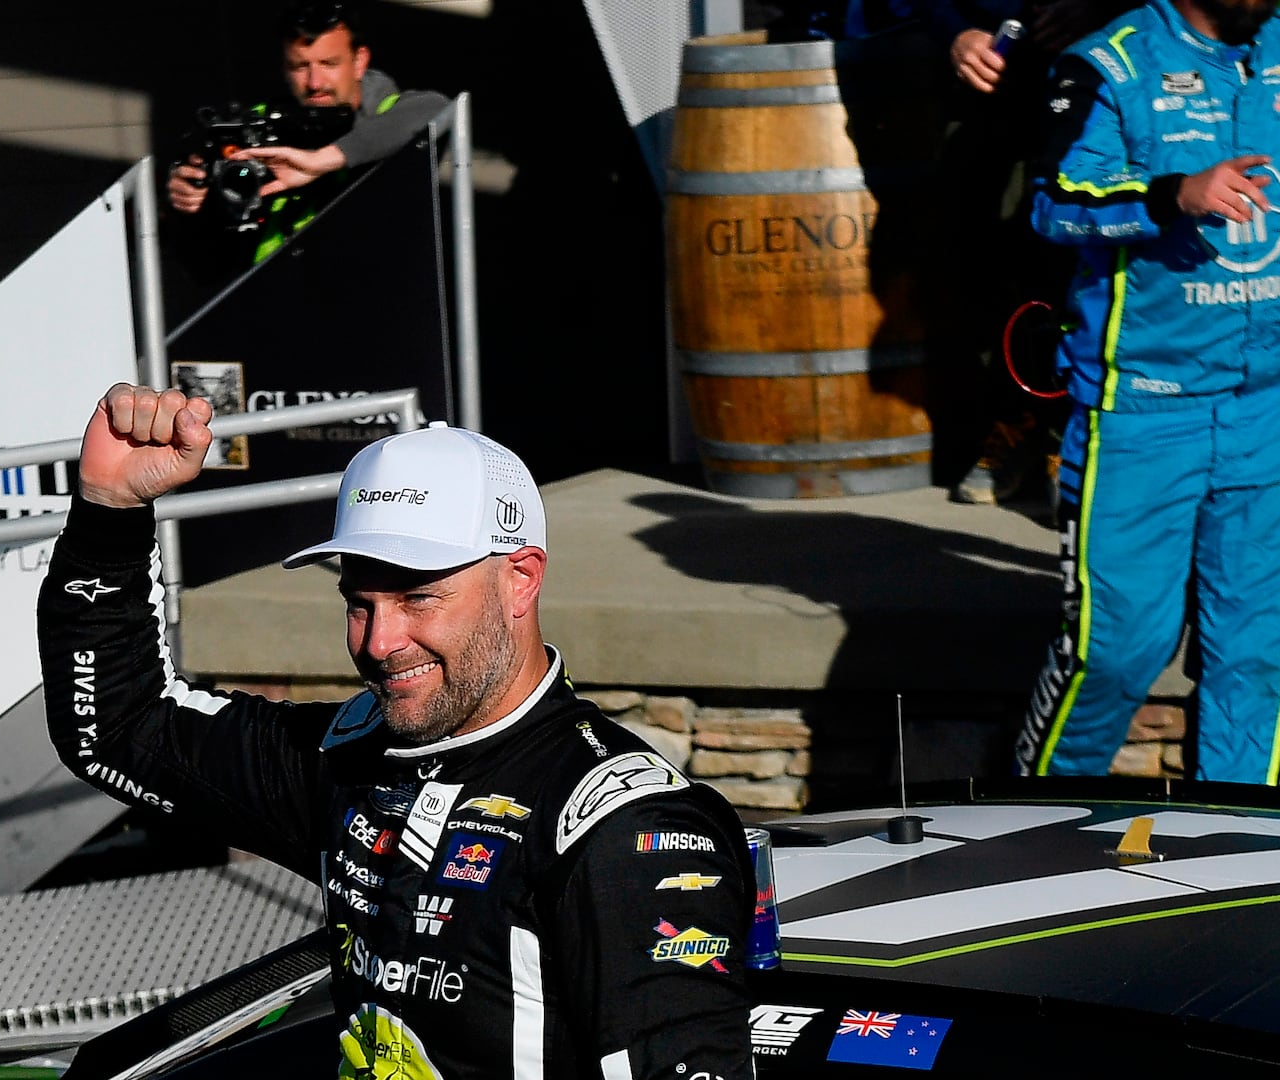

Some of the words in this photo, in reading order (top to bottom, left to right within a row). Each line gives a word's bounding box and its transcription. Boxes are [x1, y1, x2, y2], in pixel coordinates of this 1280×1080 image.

[356, 488, 426, 506] SuperFile
[73, 650, 96, 717] GIVES
[658, 831, 716, 852] NASCAR
[655, 937, 729, 958] SUNOCO
